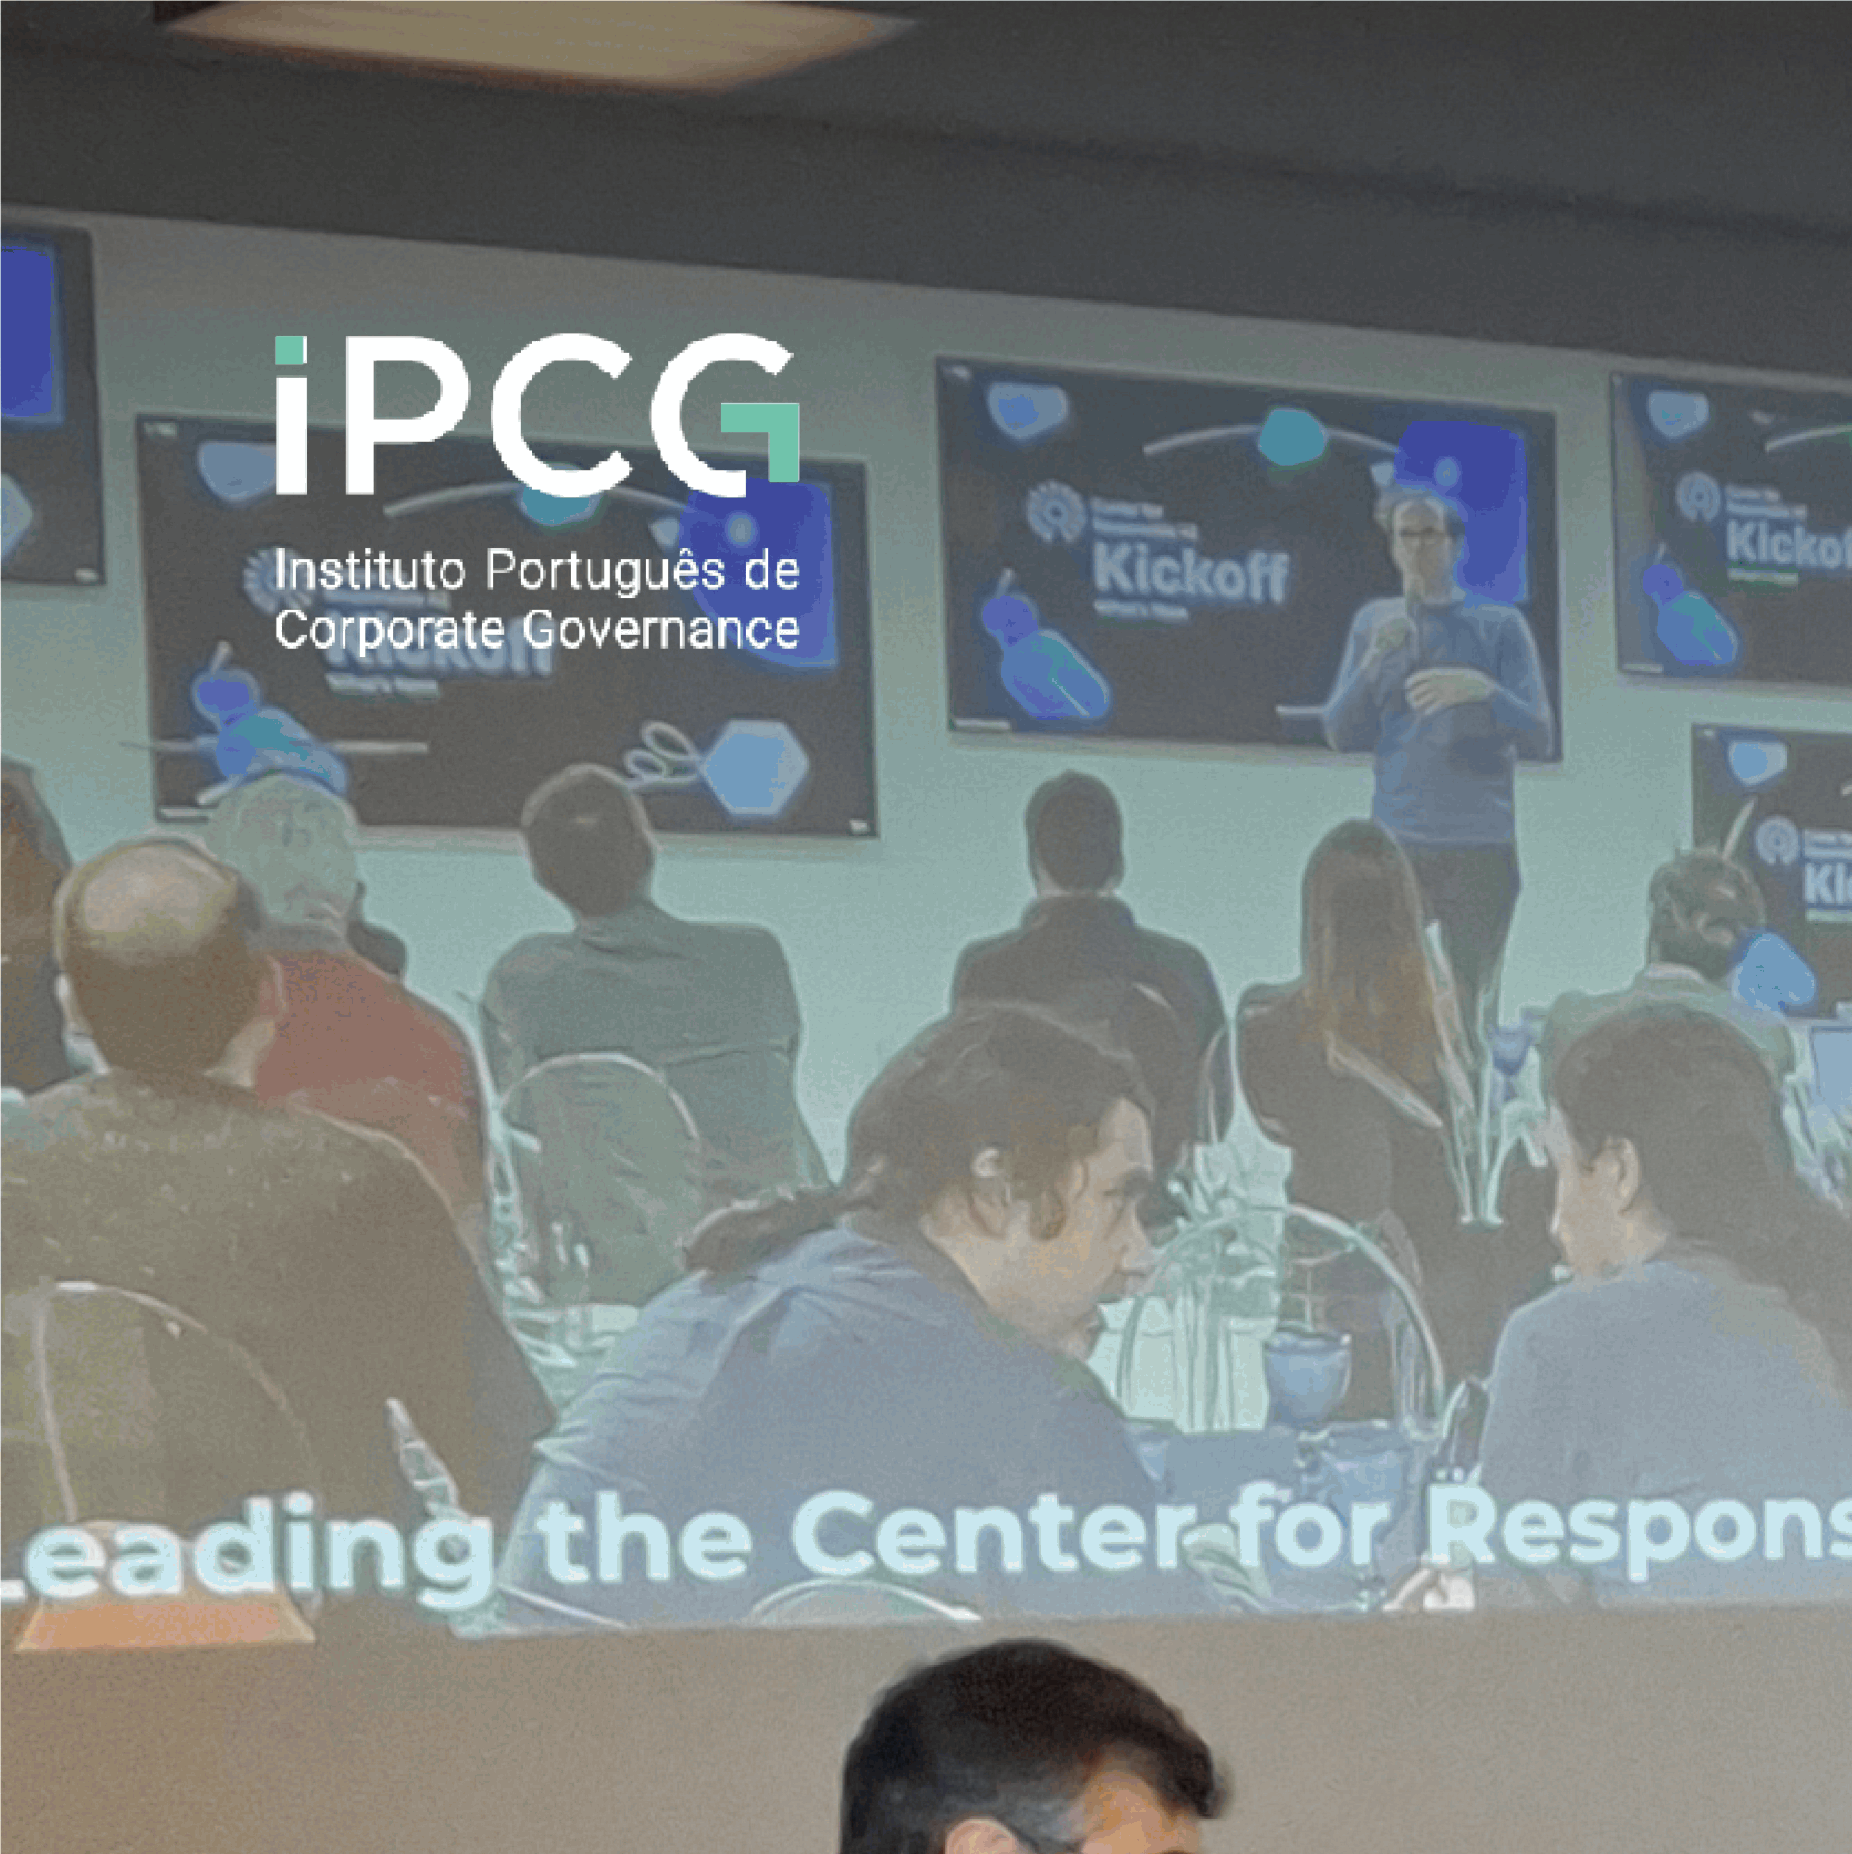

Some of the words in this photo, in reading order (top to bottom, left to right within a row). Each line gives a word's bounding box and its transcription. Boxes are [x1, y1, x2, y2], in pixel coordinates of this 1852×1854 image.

[1092, 541, 1290, 604] Kickoff
[536, 1488, 752, 1583] the
[791, 1488, 1197, 1577] Center
[1233, 1480, 1390, 1568] for
